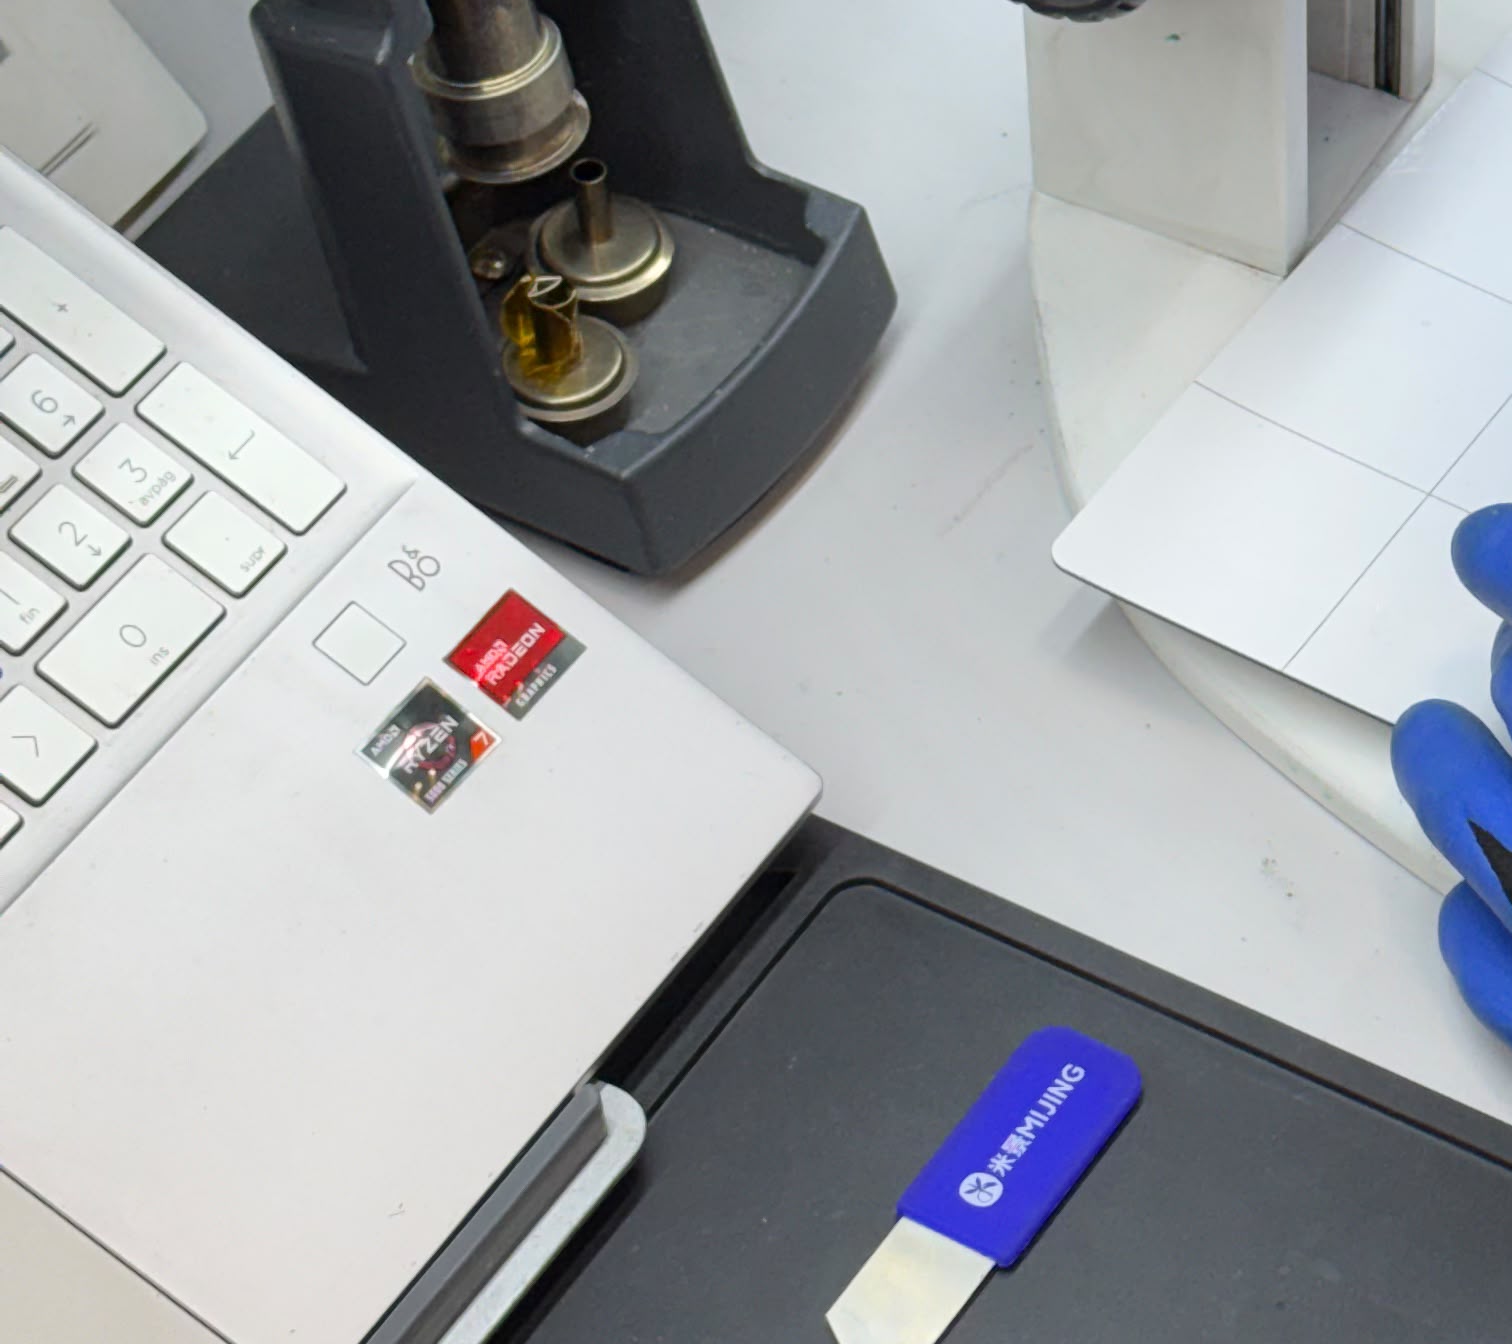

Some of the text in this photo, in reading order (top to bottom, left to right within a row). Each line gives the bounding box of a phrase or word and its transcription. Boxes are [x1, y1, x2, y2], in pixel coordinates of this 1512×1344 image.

[31, 389, 58, 414] 6
[118, 457, 147, 483] 3
[58, 521, 88, 547] 2
[485, 622, 546, 686] RADEON
[515, 663, 557, 708] GRAPHICS
[402, 714, 460, 774] RYZEN
[472, 731, 490, 747] 7
